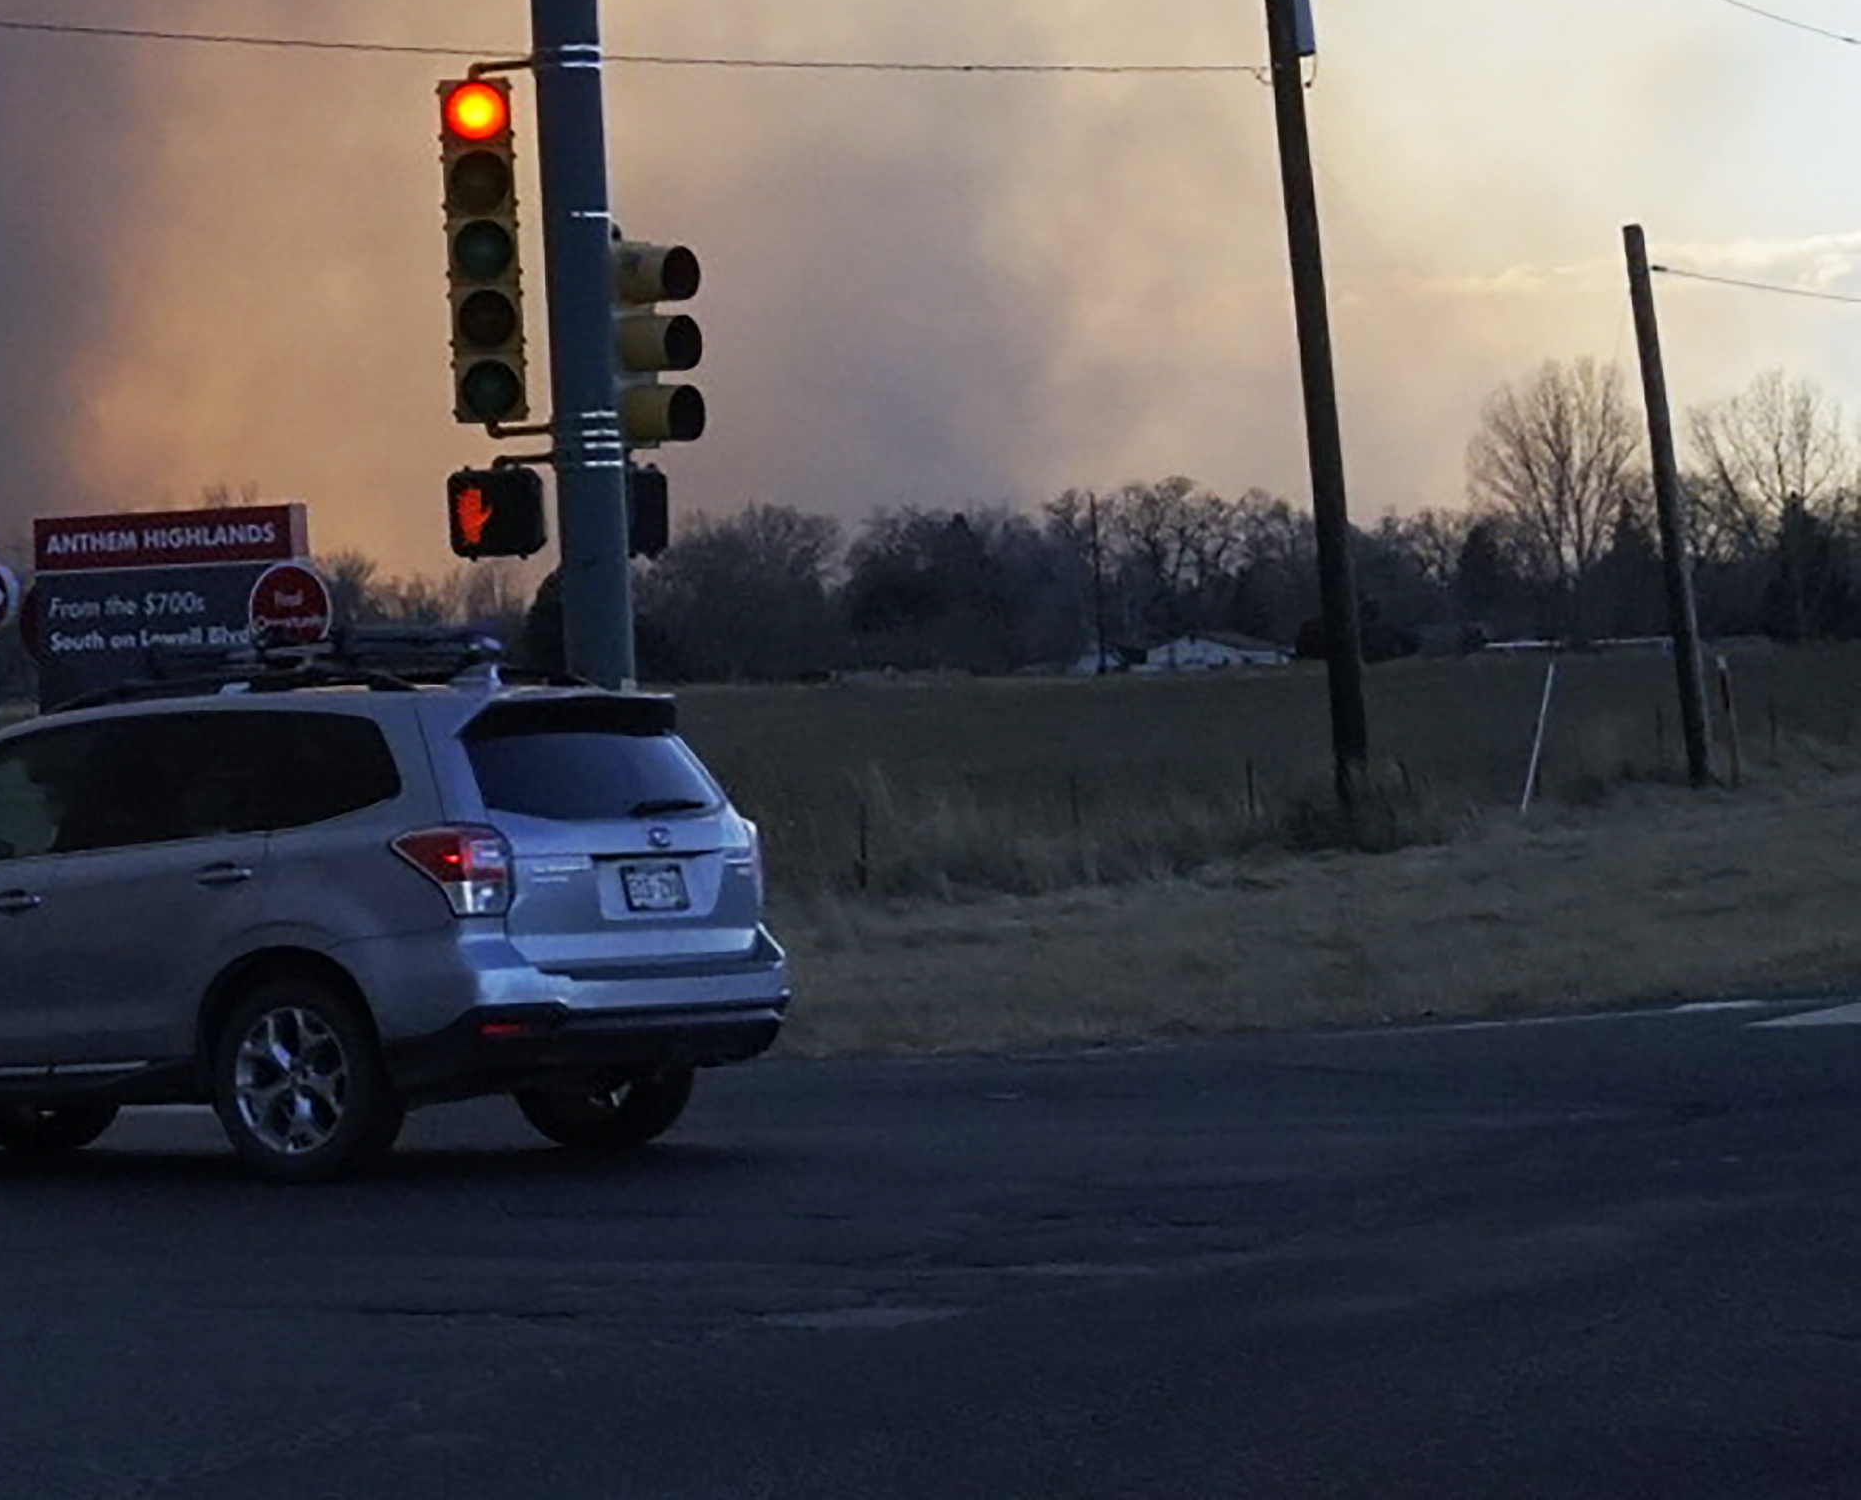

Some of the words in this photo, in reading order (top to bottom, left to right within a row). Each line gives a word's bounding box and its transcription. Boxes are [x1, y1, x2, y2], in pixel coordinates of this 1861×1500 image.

[46, 530, 137, 555] ANTHEM
[143, 522, 276, 549] HIGHLANDS
[48, 596, 101, 618] From
[104, 594, 138, 615] the
[143, 591, 206, 615] $700s
[49, 629, 105, 652] South
[110, 634, 137, 649] on
[140, 627, 202, 647] Lowell
